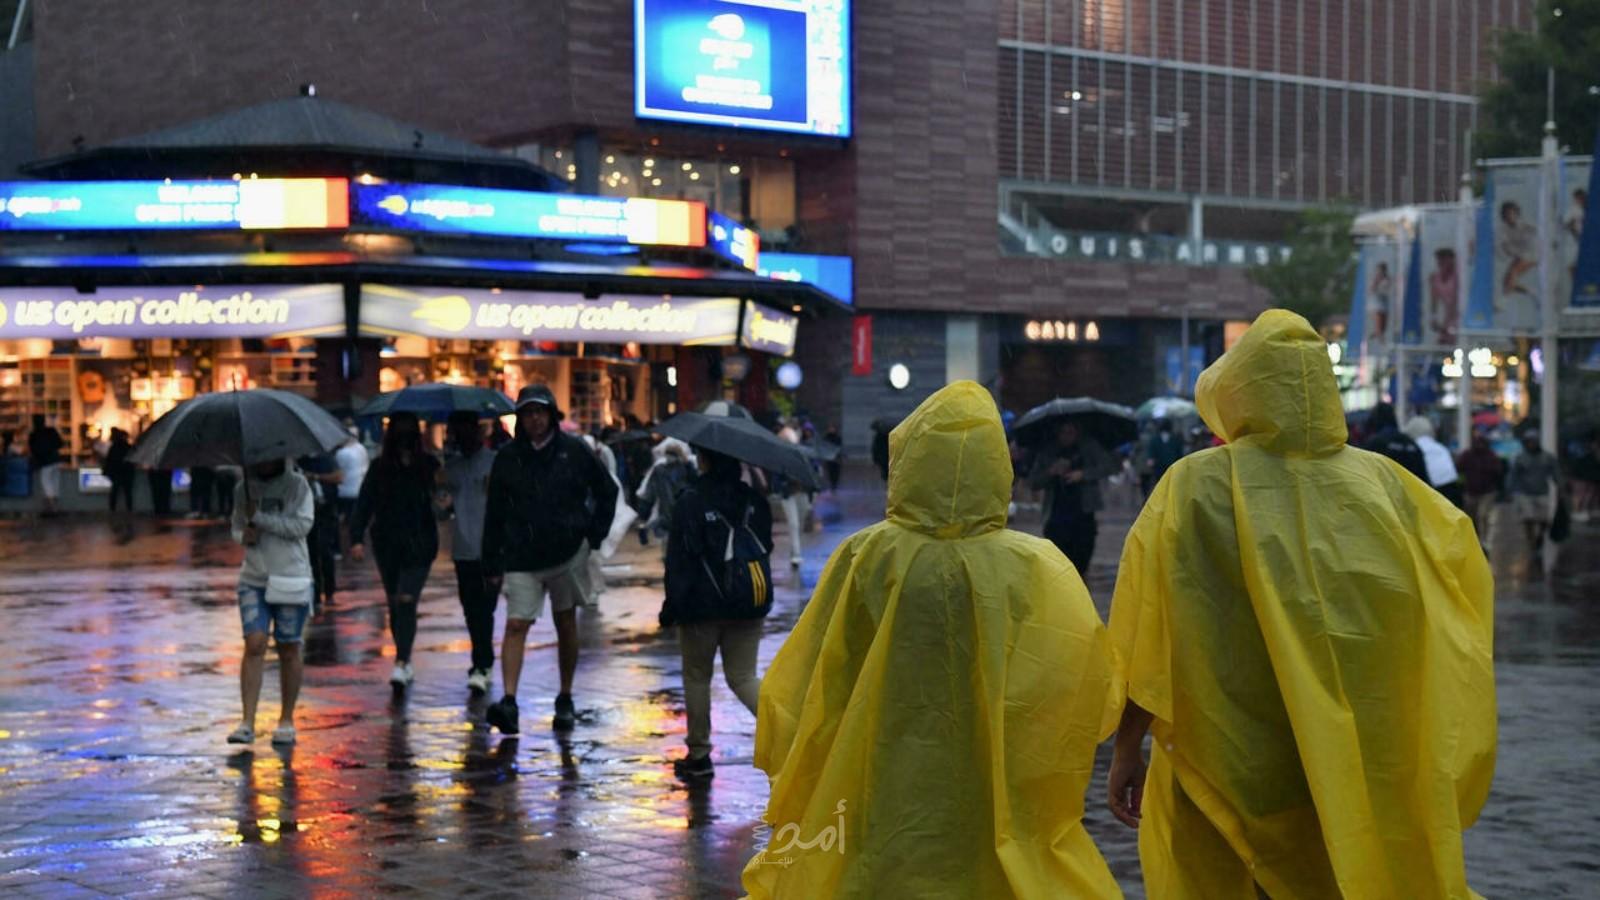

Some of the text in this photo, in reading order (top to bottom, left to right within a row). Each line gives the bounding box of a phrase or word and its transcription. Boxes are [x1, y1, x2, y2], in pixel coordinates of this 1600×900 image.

[1026, 235, 1142, 258] LOUIS
[15, 293, 289, 332] us open collection
[476, 301, 697, 334] us open collection
[1085, 320, 1100, 341] A
